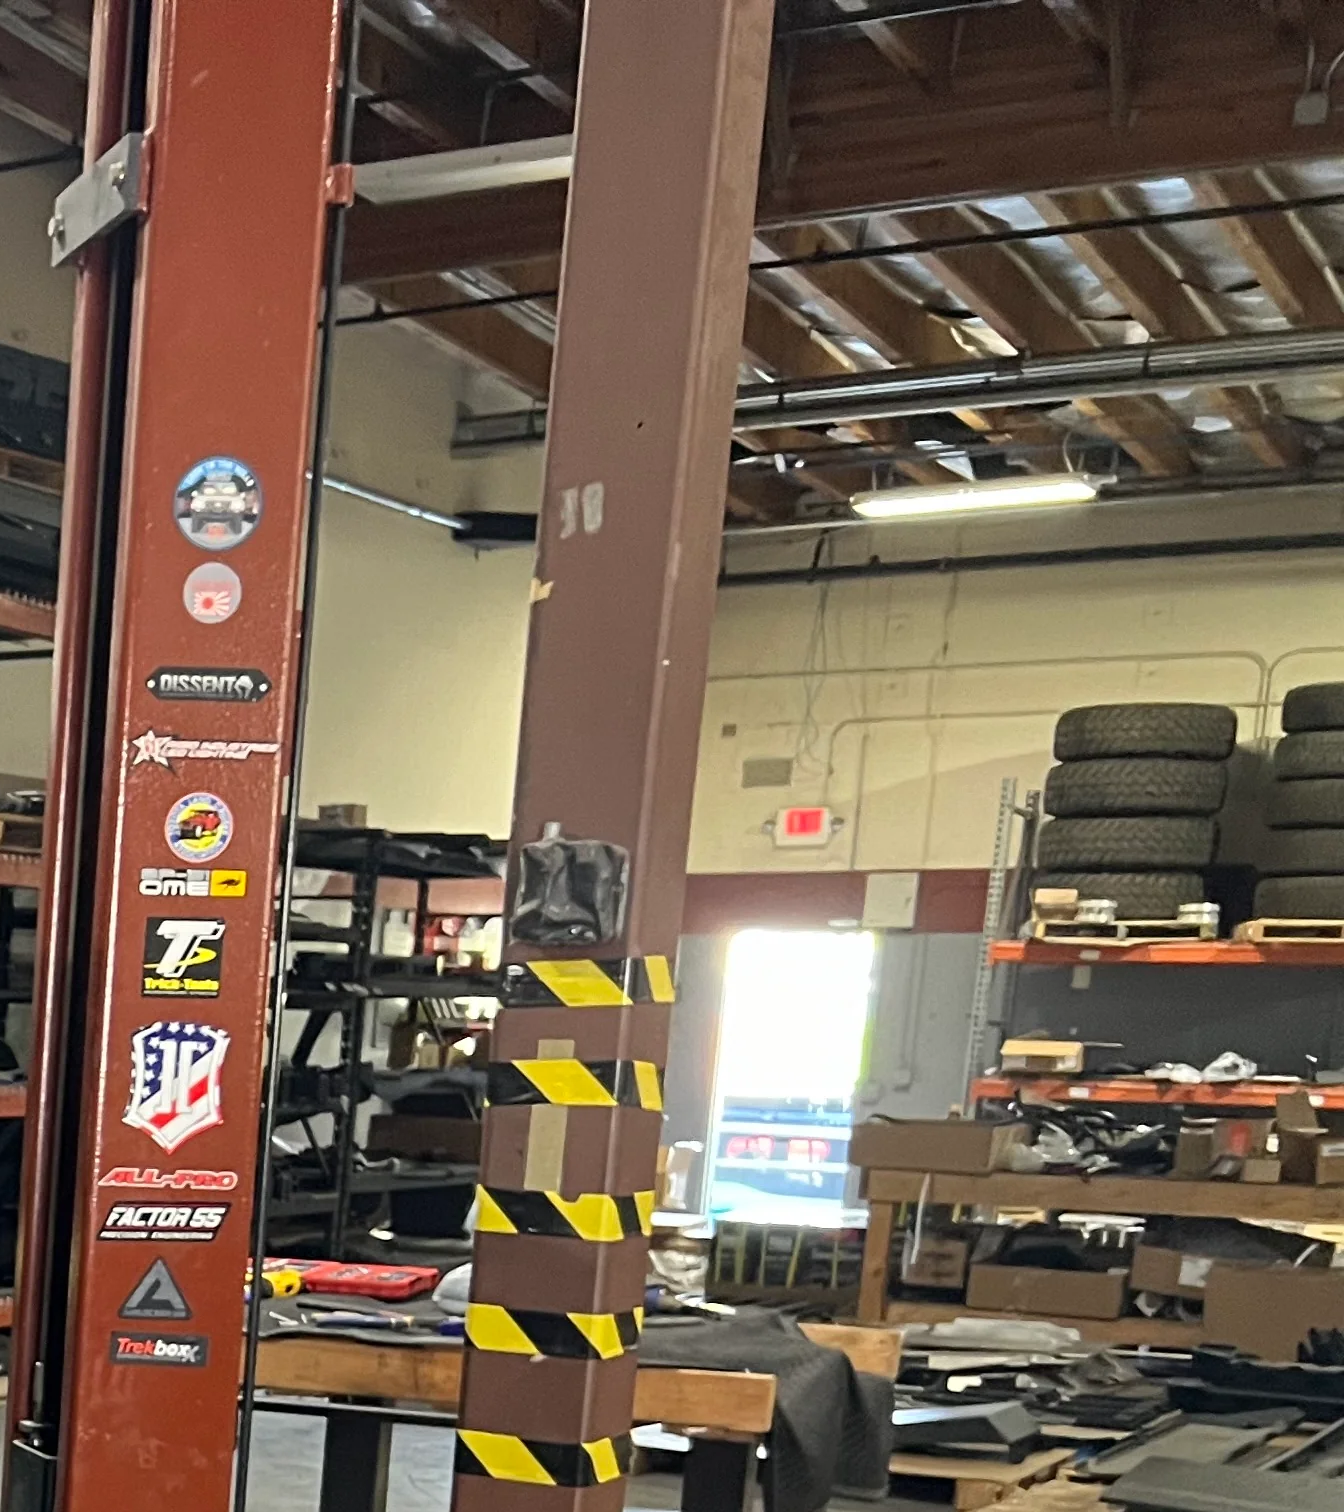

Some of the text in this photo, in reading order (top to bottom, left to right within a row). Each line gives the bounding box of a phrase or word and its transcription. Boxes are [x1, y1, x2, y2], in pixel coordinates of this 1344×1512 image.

[159, 673, 237, 693] DISSENT
[139, 880, 209, 896] OME
[99, 1168, 238, 1190] ALL-PRO
[105, 1206, 227, 1228] FACTOR 55
